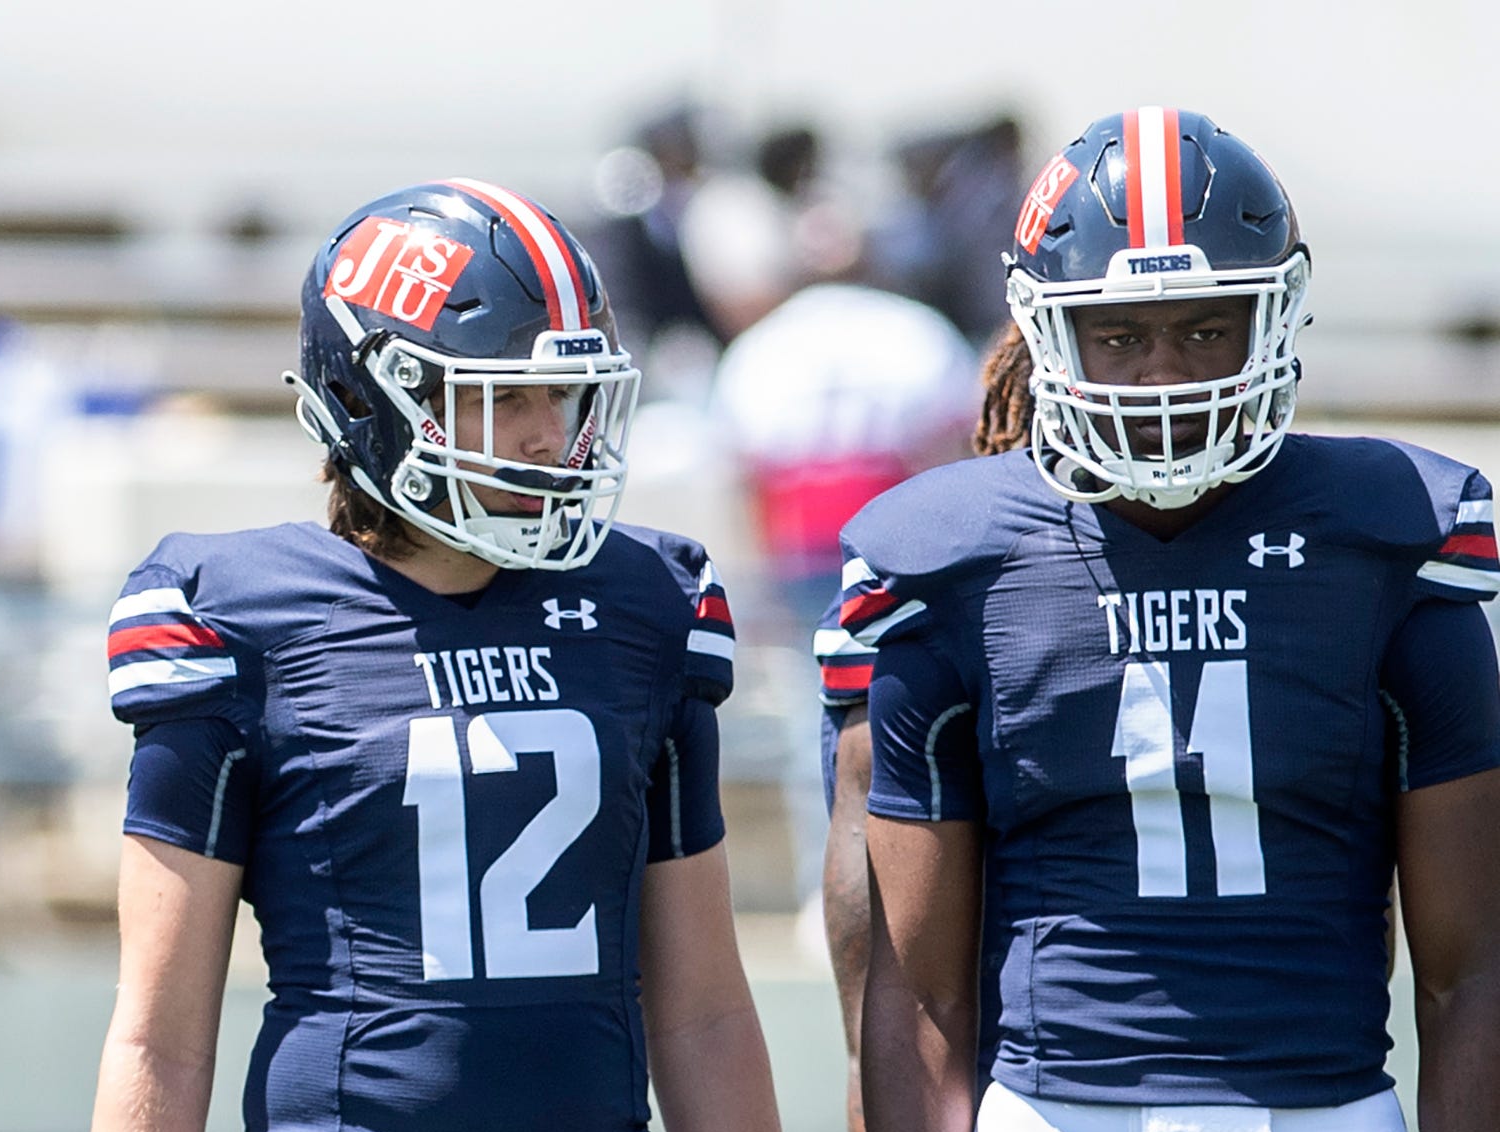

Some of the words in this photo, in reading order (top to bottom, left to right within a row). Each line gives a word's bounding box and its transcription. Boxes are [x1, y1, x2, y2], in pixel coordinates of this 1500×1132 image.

[1020, 160, 1072, 247] SU
[331, 221, 458, 322] JSU
[1127, 254, 1192, 275] TIGERS
[553, 336, 604, 356] TIGERS
[567, 414, 597, 470] Riddell
[1152, 463, 1192, 479] Ridell
[1097, 588, 1247, 654] TIGERS
[413, 646, 560, 709] TIGERS
[1110, 659, 1267, 898] 11
[402, 708, 601, 982] 12
